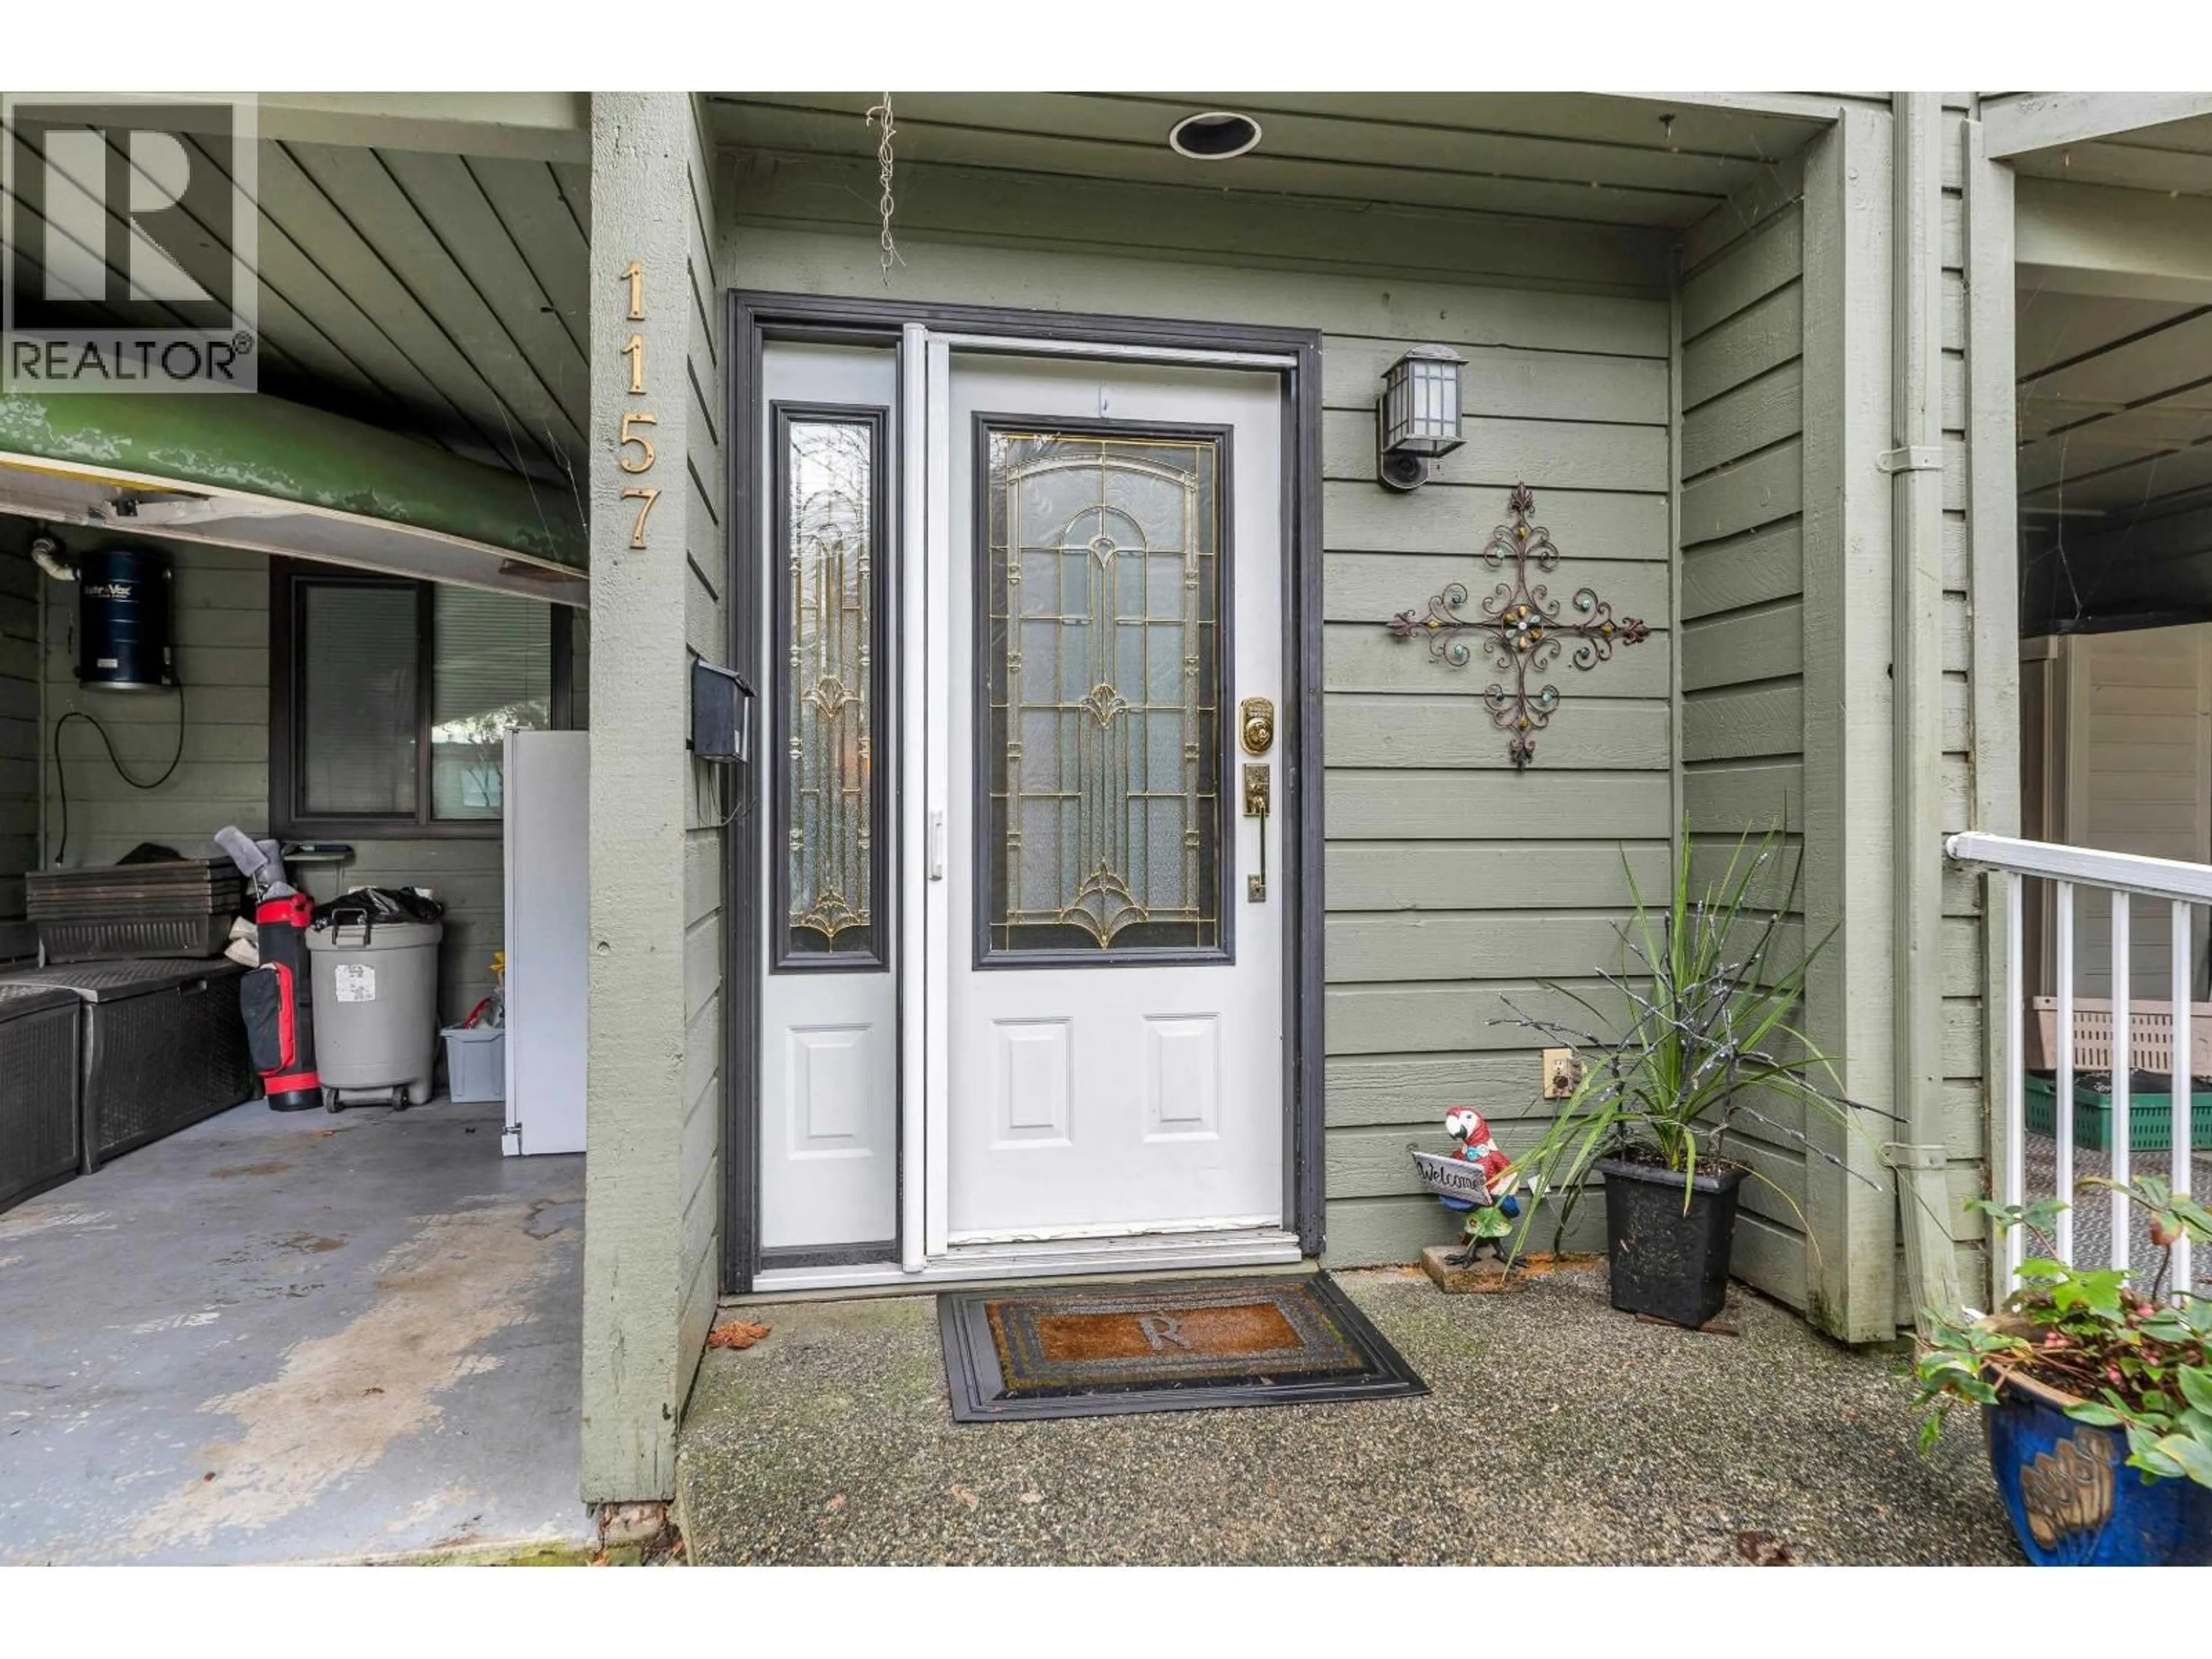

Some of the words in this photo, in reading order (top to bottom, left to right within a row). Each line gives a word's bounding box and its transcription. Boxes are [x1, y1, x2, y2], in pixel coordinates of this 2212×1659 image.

[619, 259, 662, 550] 1157
[1416, 1161, 1480, 1191] Welcome
[1138, 1315, 1192, 1350] R
